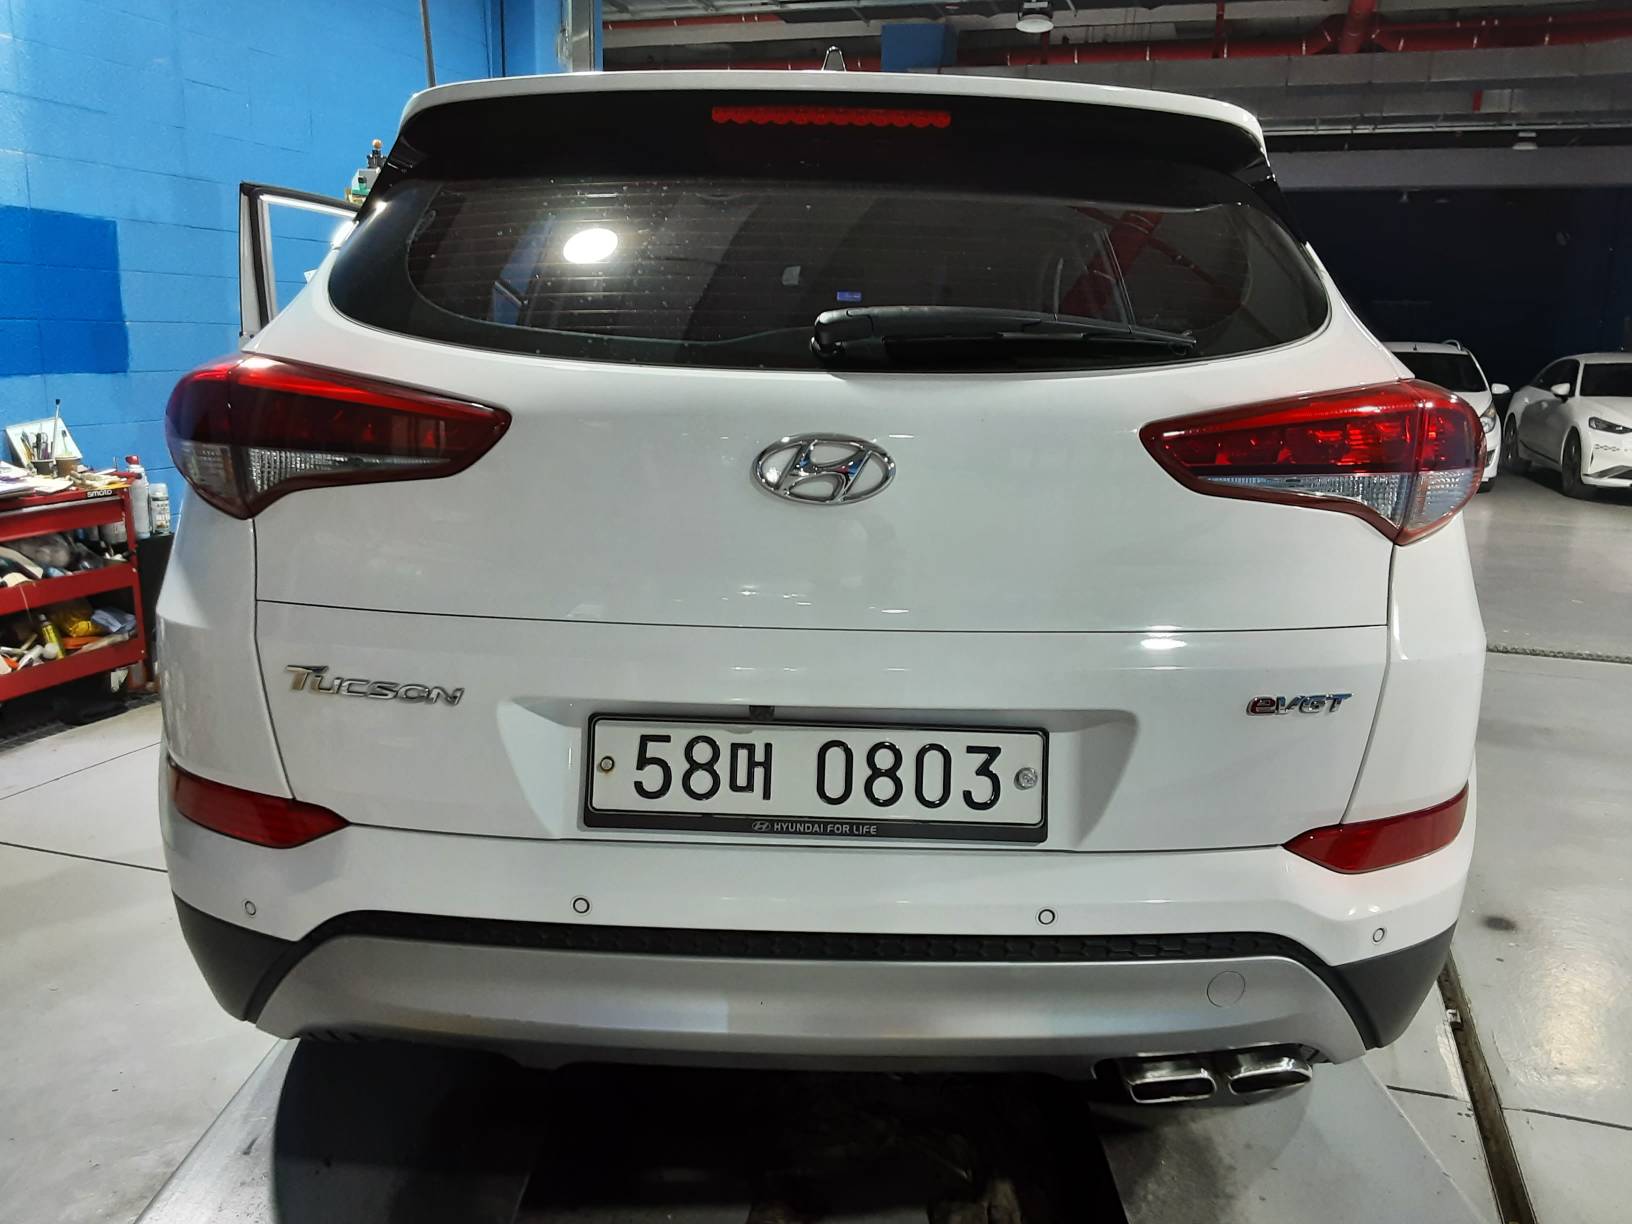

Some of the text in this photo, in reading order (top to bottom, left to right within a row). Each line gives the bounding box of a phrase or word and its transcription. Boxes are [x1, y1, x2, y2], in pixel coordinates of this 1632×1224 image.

[633, 734, 1003, 811] 58머 0803
[773, 822, 878, 836] HYUNDAI FOR LIFE
